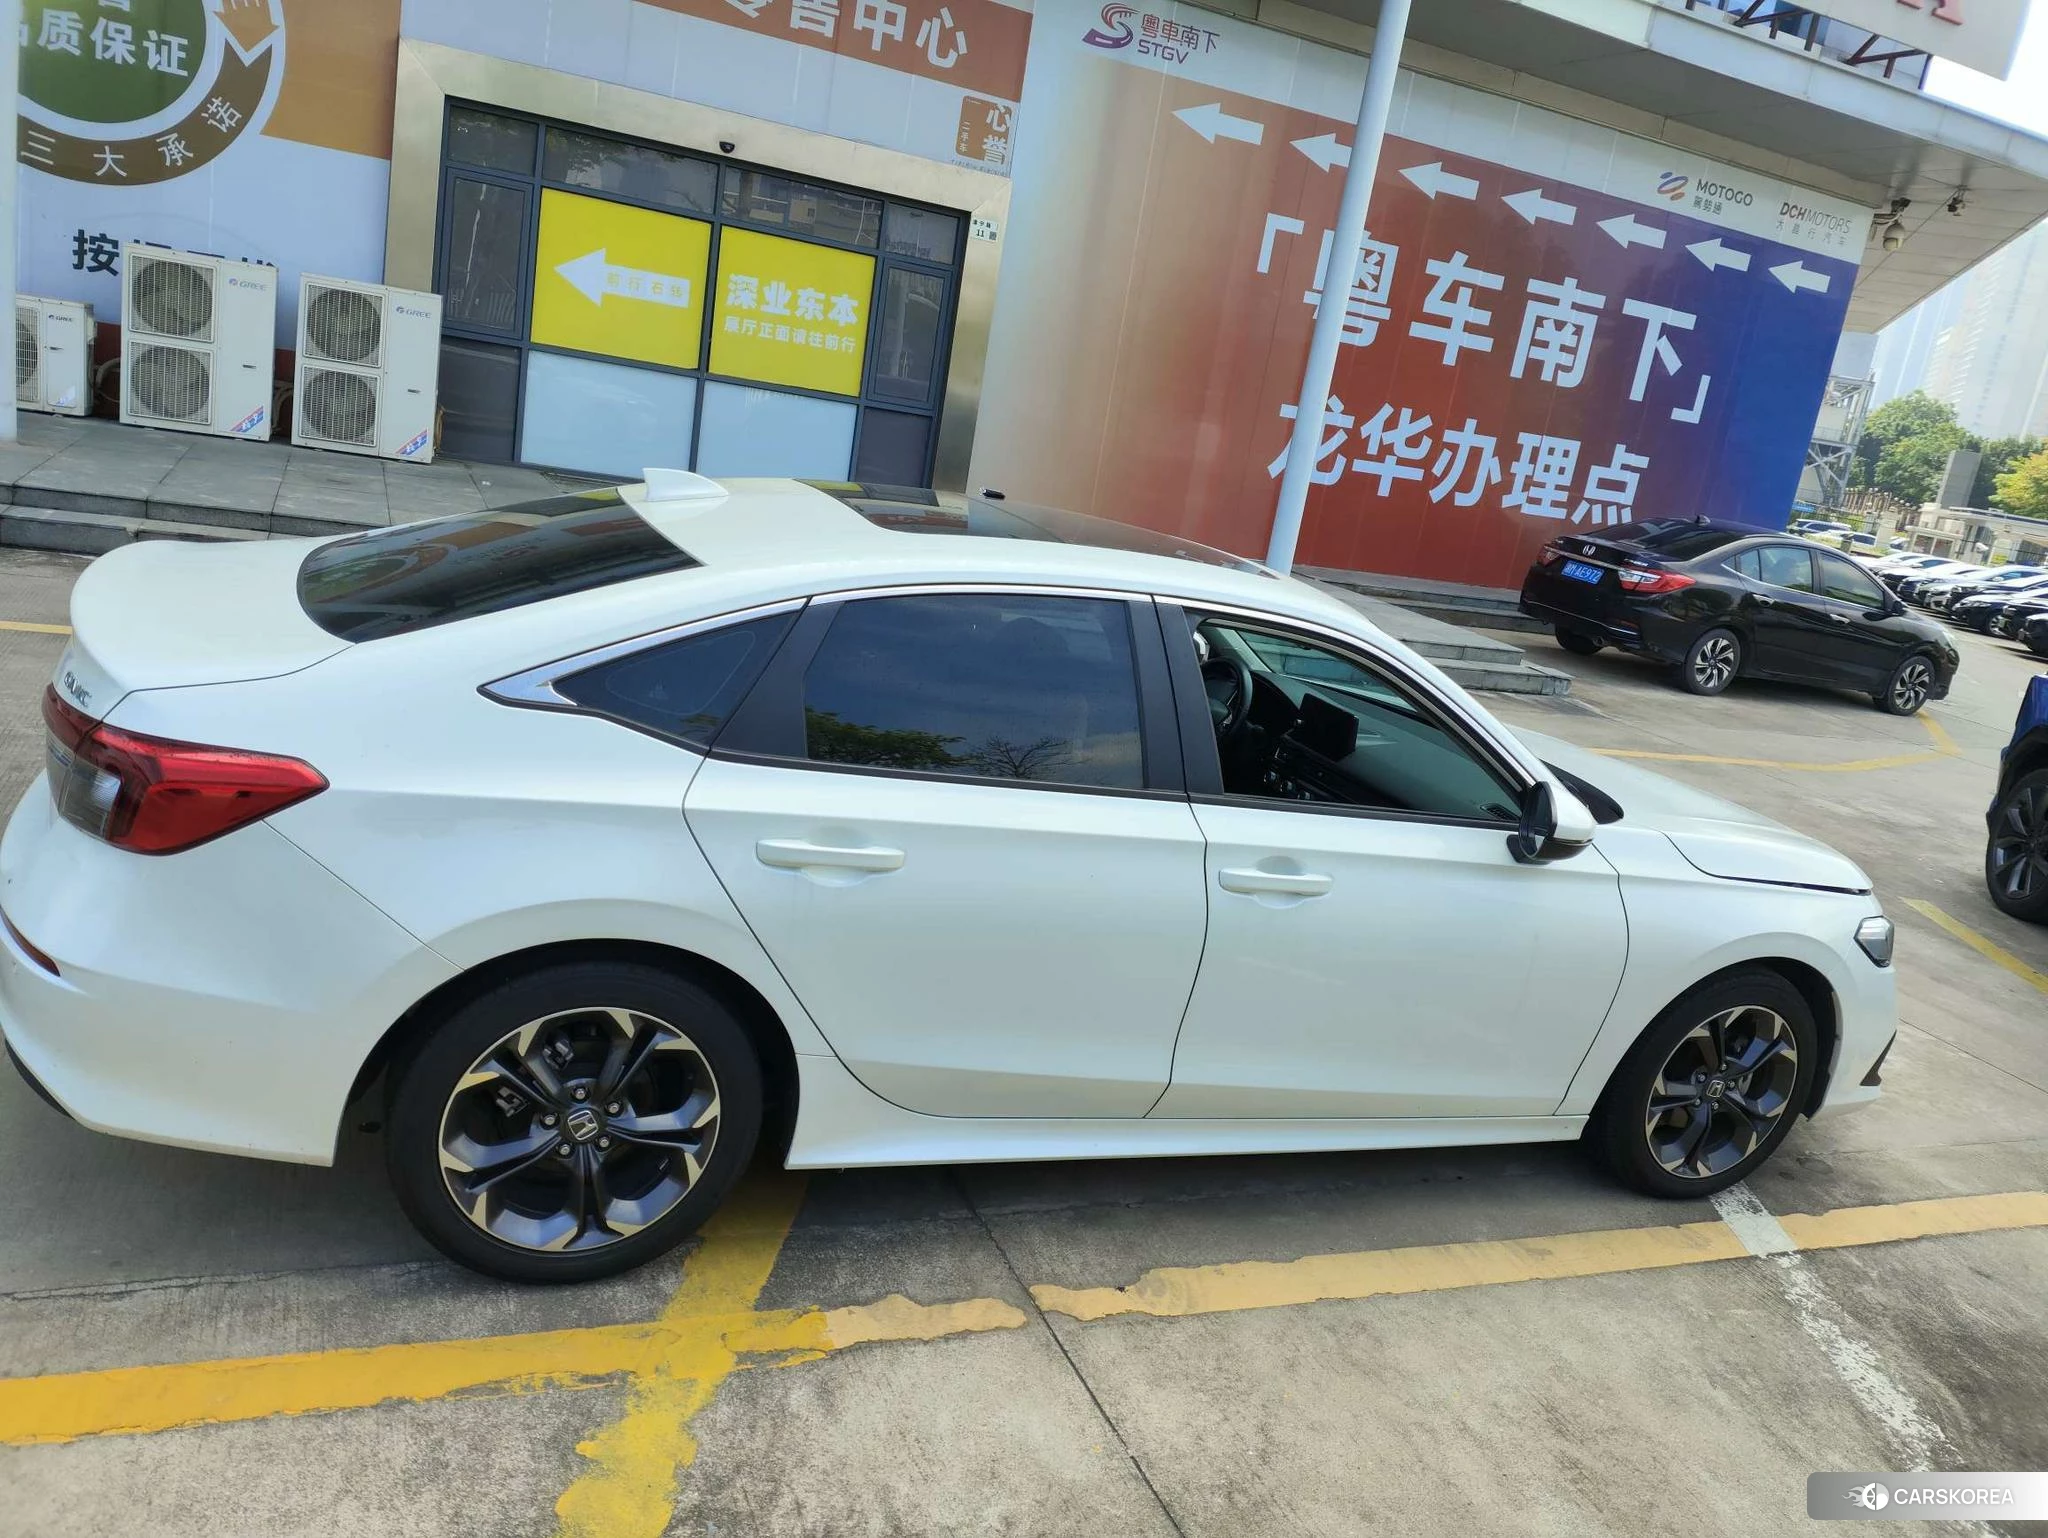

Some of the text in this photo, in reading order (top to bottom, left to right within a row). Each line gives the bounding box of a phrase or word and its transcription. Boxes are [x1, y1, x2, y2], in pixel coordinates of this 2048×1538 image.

[725, 0, 968, 69] 售中心
[1137, 39, 1189, 65] STGV
[21, 96, 243, 178] 三大承诺
[1696, 178, 1754, 207] MOTOGO
[725, 273, 859, 328] 深业东本
